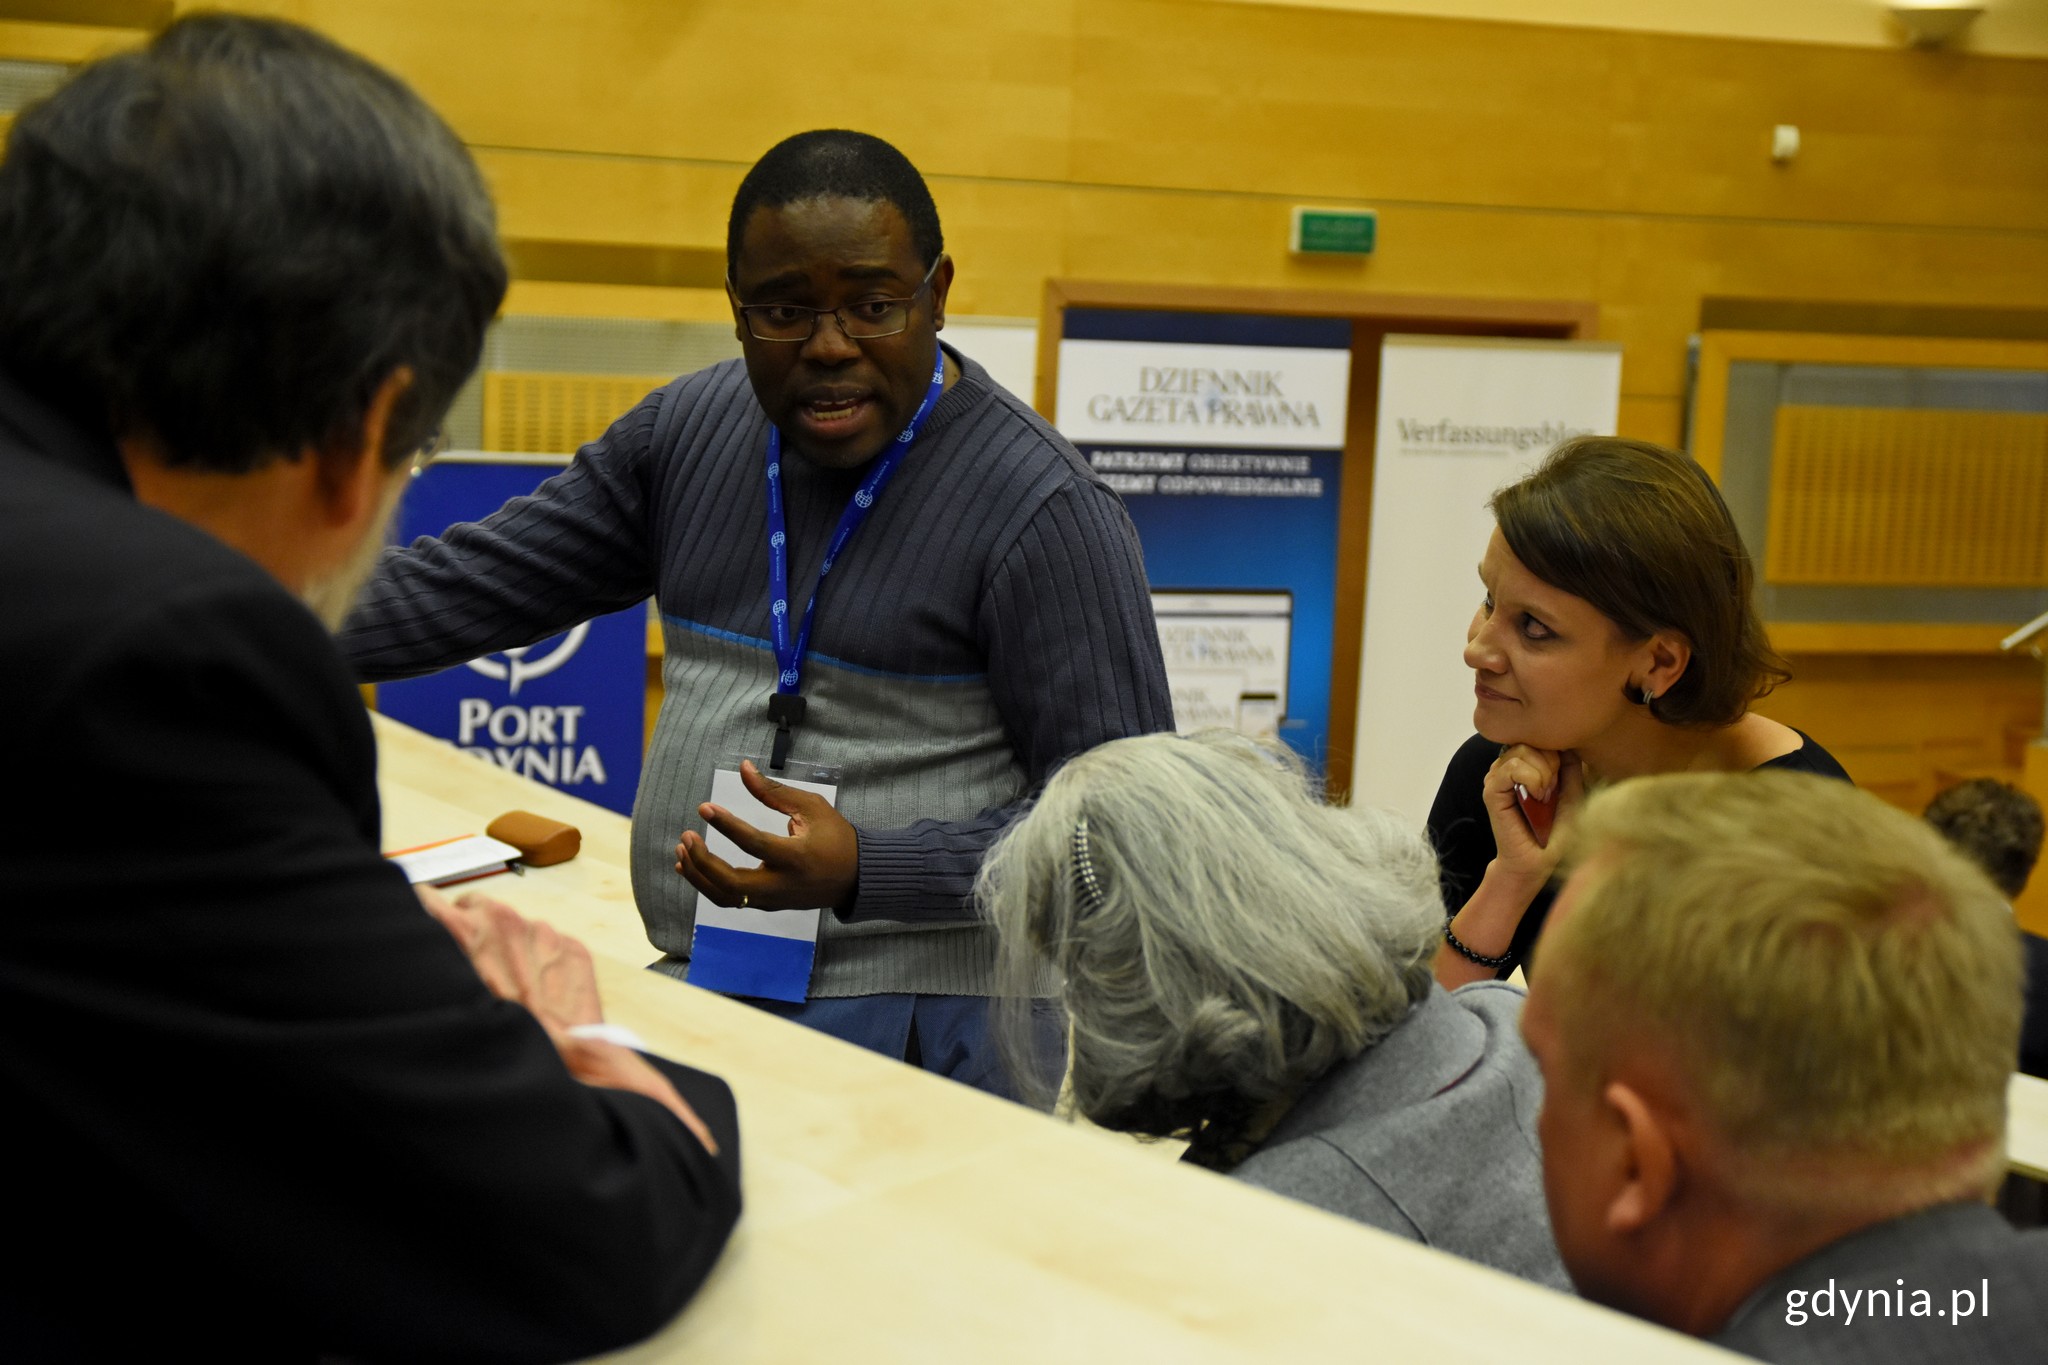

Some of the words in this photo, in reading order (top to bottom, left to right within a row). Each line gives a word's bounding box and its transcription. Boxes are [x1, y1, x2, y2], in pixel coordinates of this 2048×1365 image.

[1139, 366, 1284, 396] DZIENNIK
[1087, 393, 1200, 425] GAZETA
[1206, 396, 1321, 428] PRAWNA
